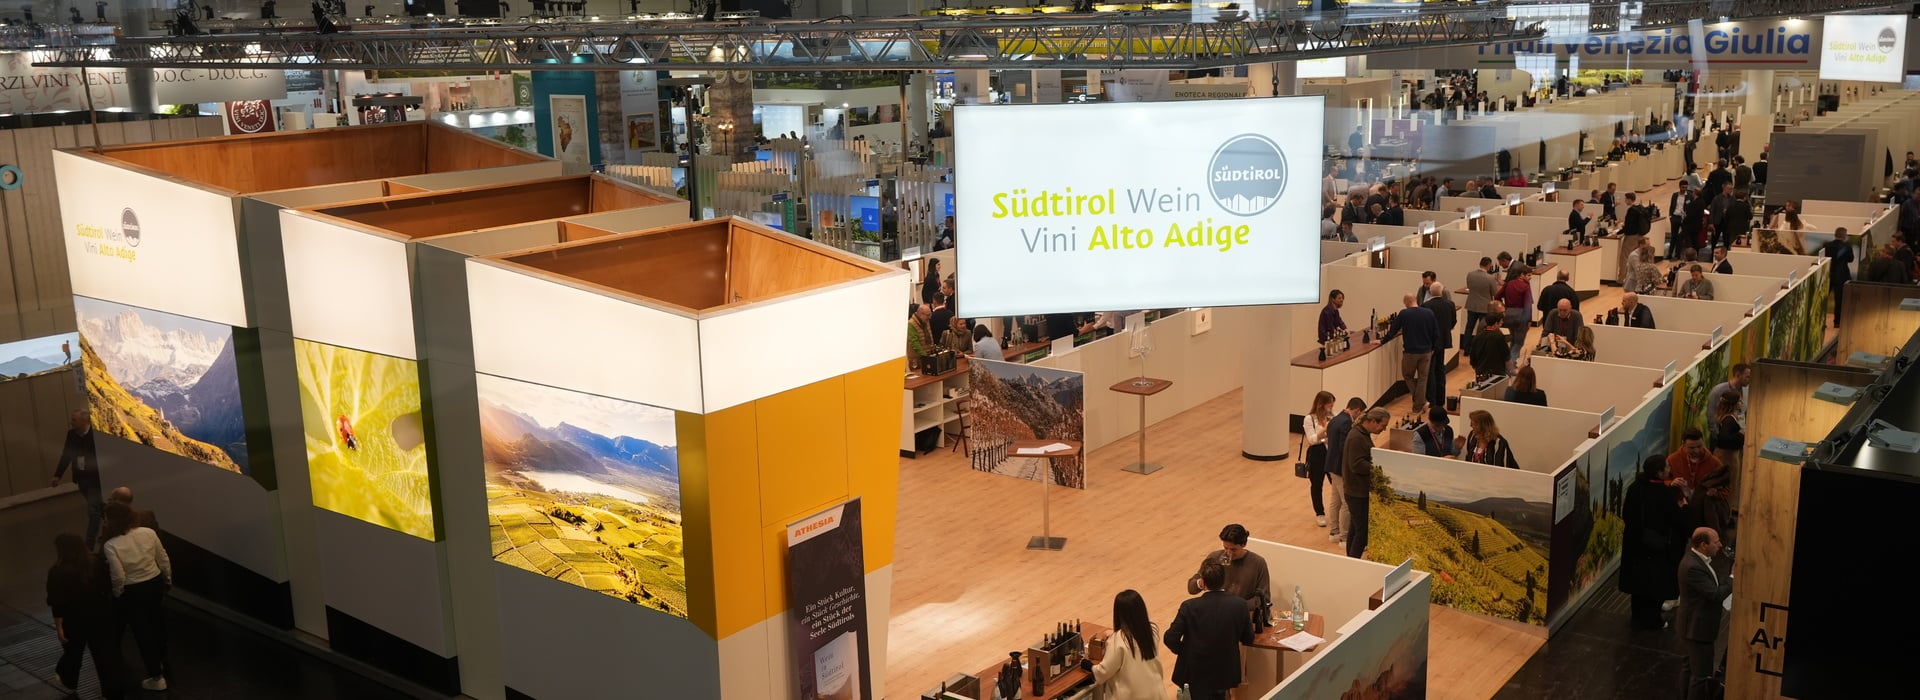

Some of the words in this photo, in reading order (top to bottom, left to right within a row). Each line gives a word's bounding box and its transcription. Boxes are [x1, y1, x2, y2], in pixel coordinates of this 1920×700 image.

[1704, 26, 1810, 55] Giulia
[31, 74, 69, 88] VINI
[208, 68, 268, 81] D.O.C.G.
[992, 187, 1115, 219] Südtirol
[1127, 187, 1201, 214] Wein
[1020, 226, 1076, 253] Vini
[1088, 224, 1154, 251] Alto
[1163, 217, 1250, 252] Adige
[794, 516, 834, 537] ATHESIA
[805, 602, 817, 613] Ein
[817, 594, 834, 607] Stück
[801, 615, 811, 625] ein
[812, 607, 828, 620] Stück
[810, 627, 827, 640] Seele
[827, 613, 855, 630] Südtirols
[811, 620, 822, 629] ein
[822, 610, 841, 624] Stück
[841, 605, 853, 615] der
[1750, 628, 1786, 650] Ar
